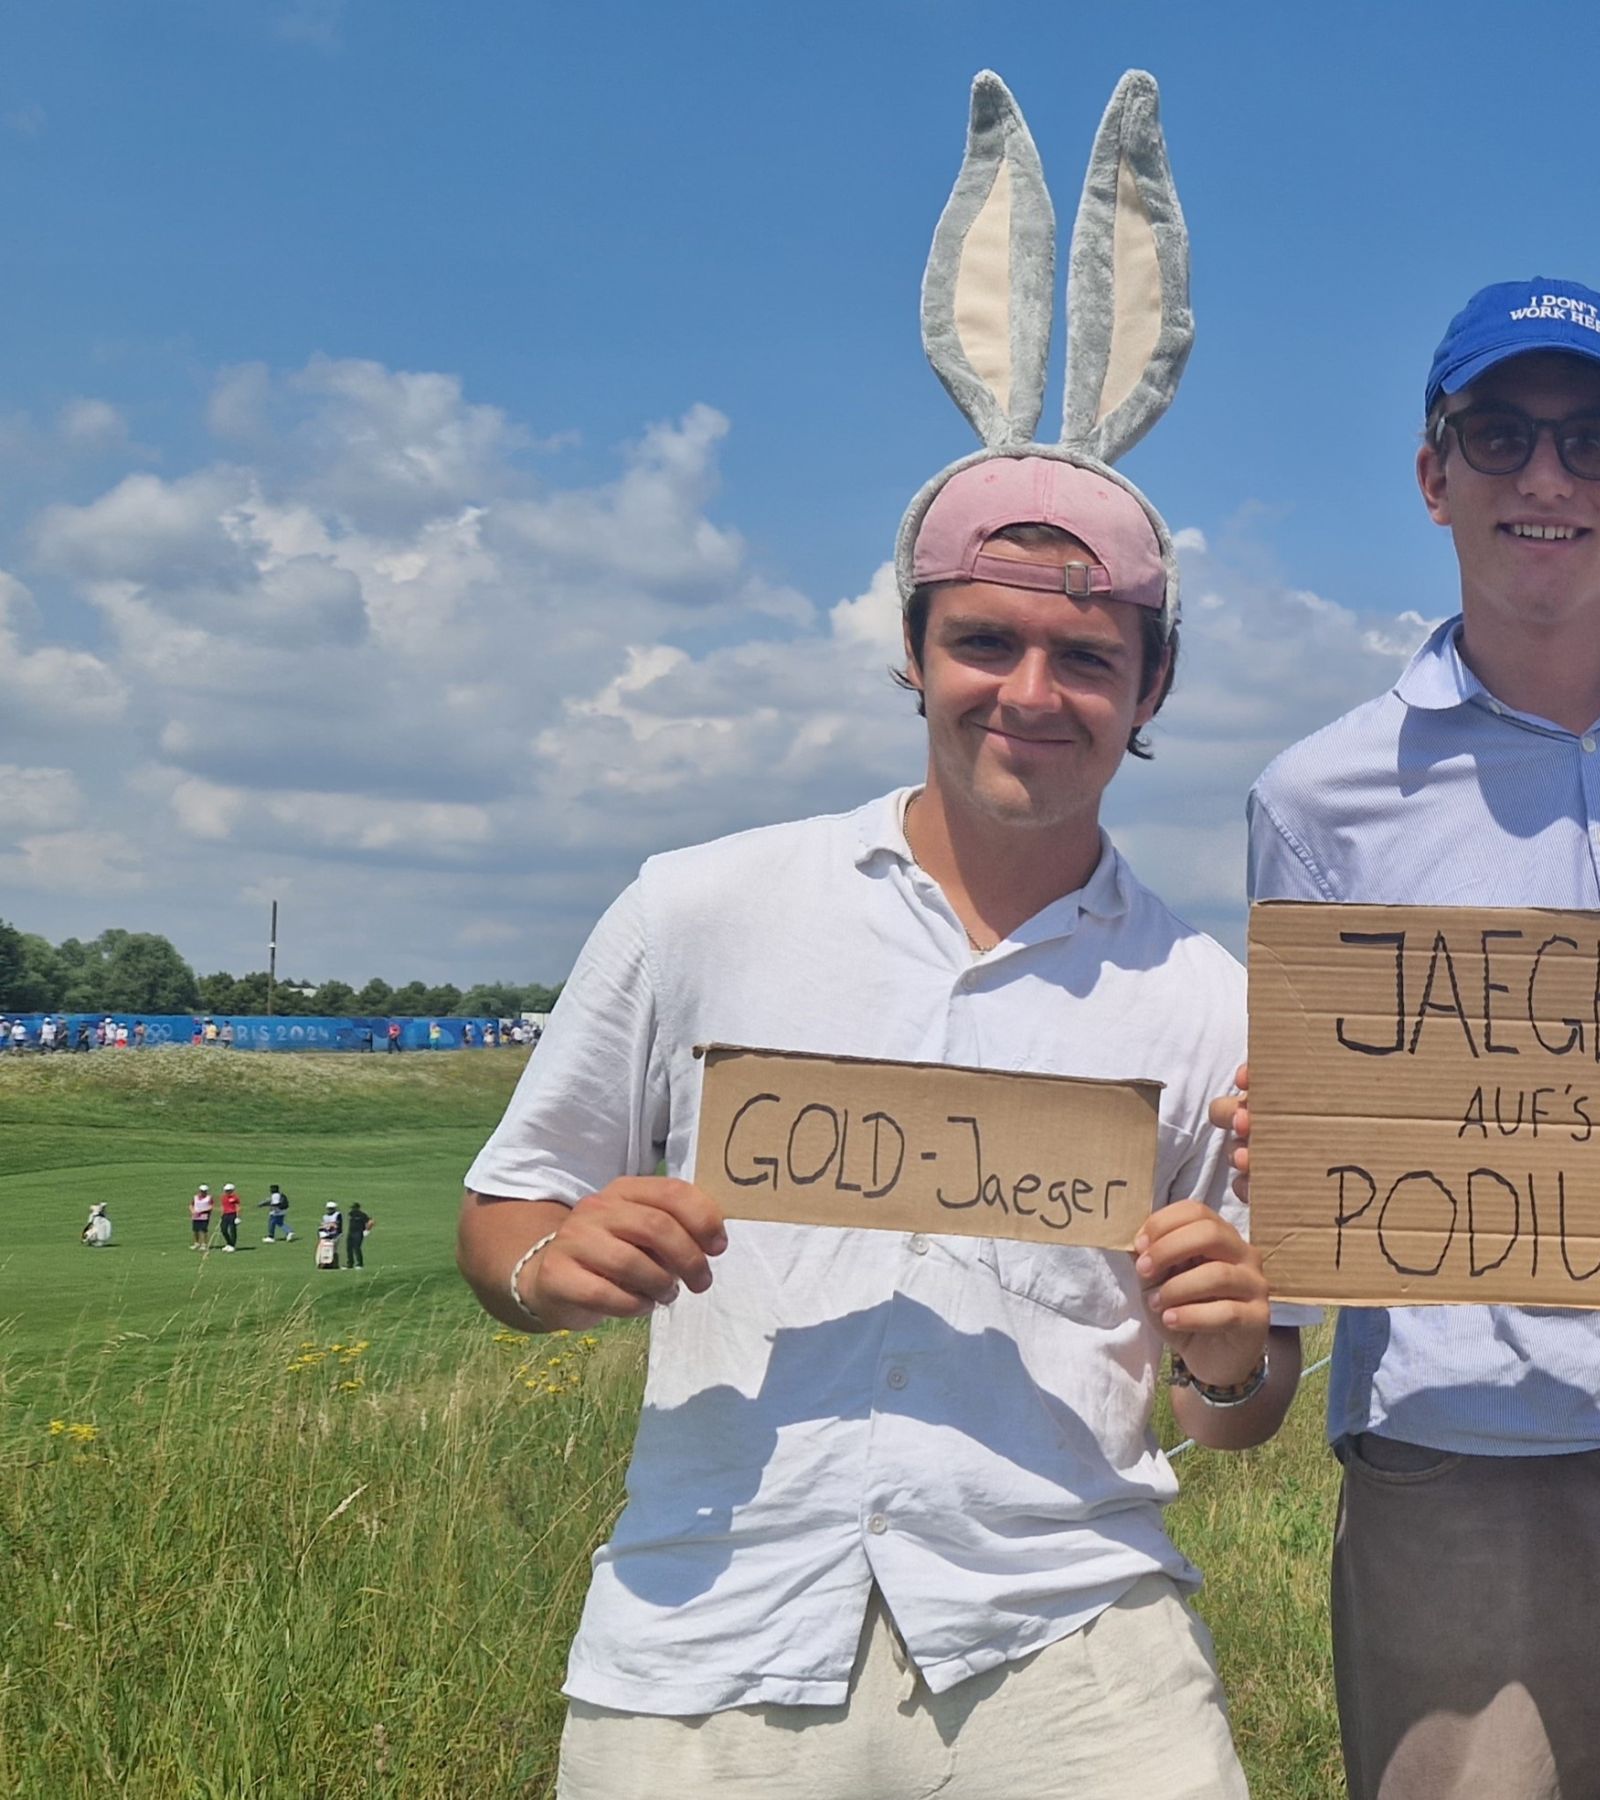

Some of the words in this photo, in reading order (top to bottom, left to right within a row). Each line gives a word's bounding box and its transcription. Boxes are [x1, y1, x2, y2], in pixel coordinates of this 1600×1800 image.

[1509, 306, 1566, 321] WORK
[1530, 296, 1538, 307] I
[1541, 294, 1598, 318] DON'T
[276, 1024, 330, 1042] 2024
